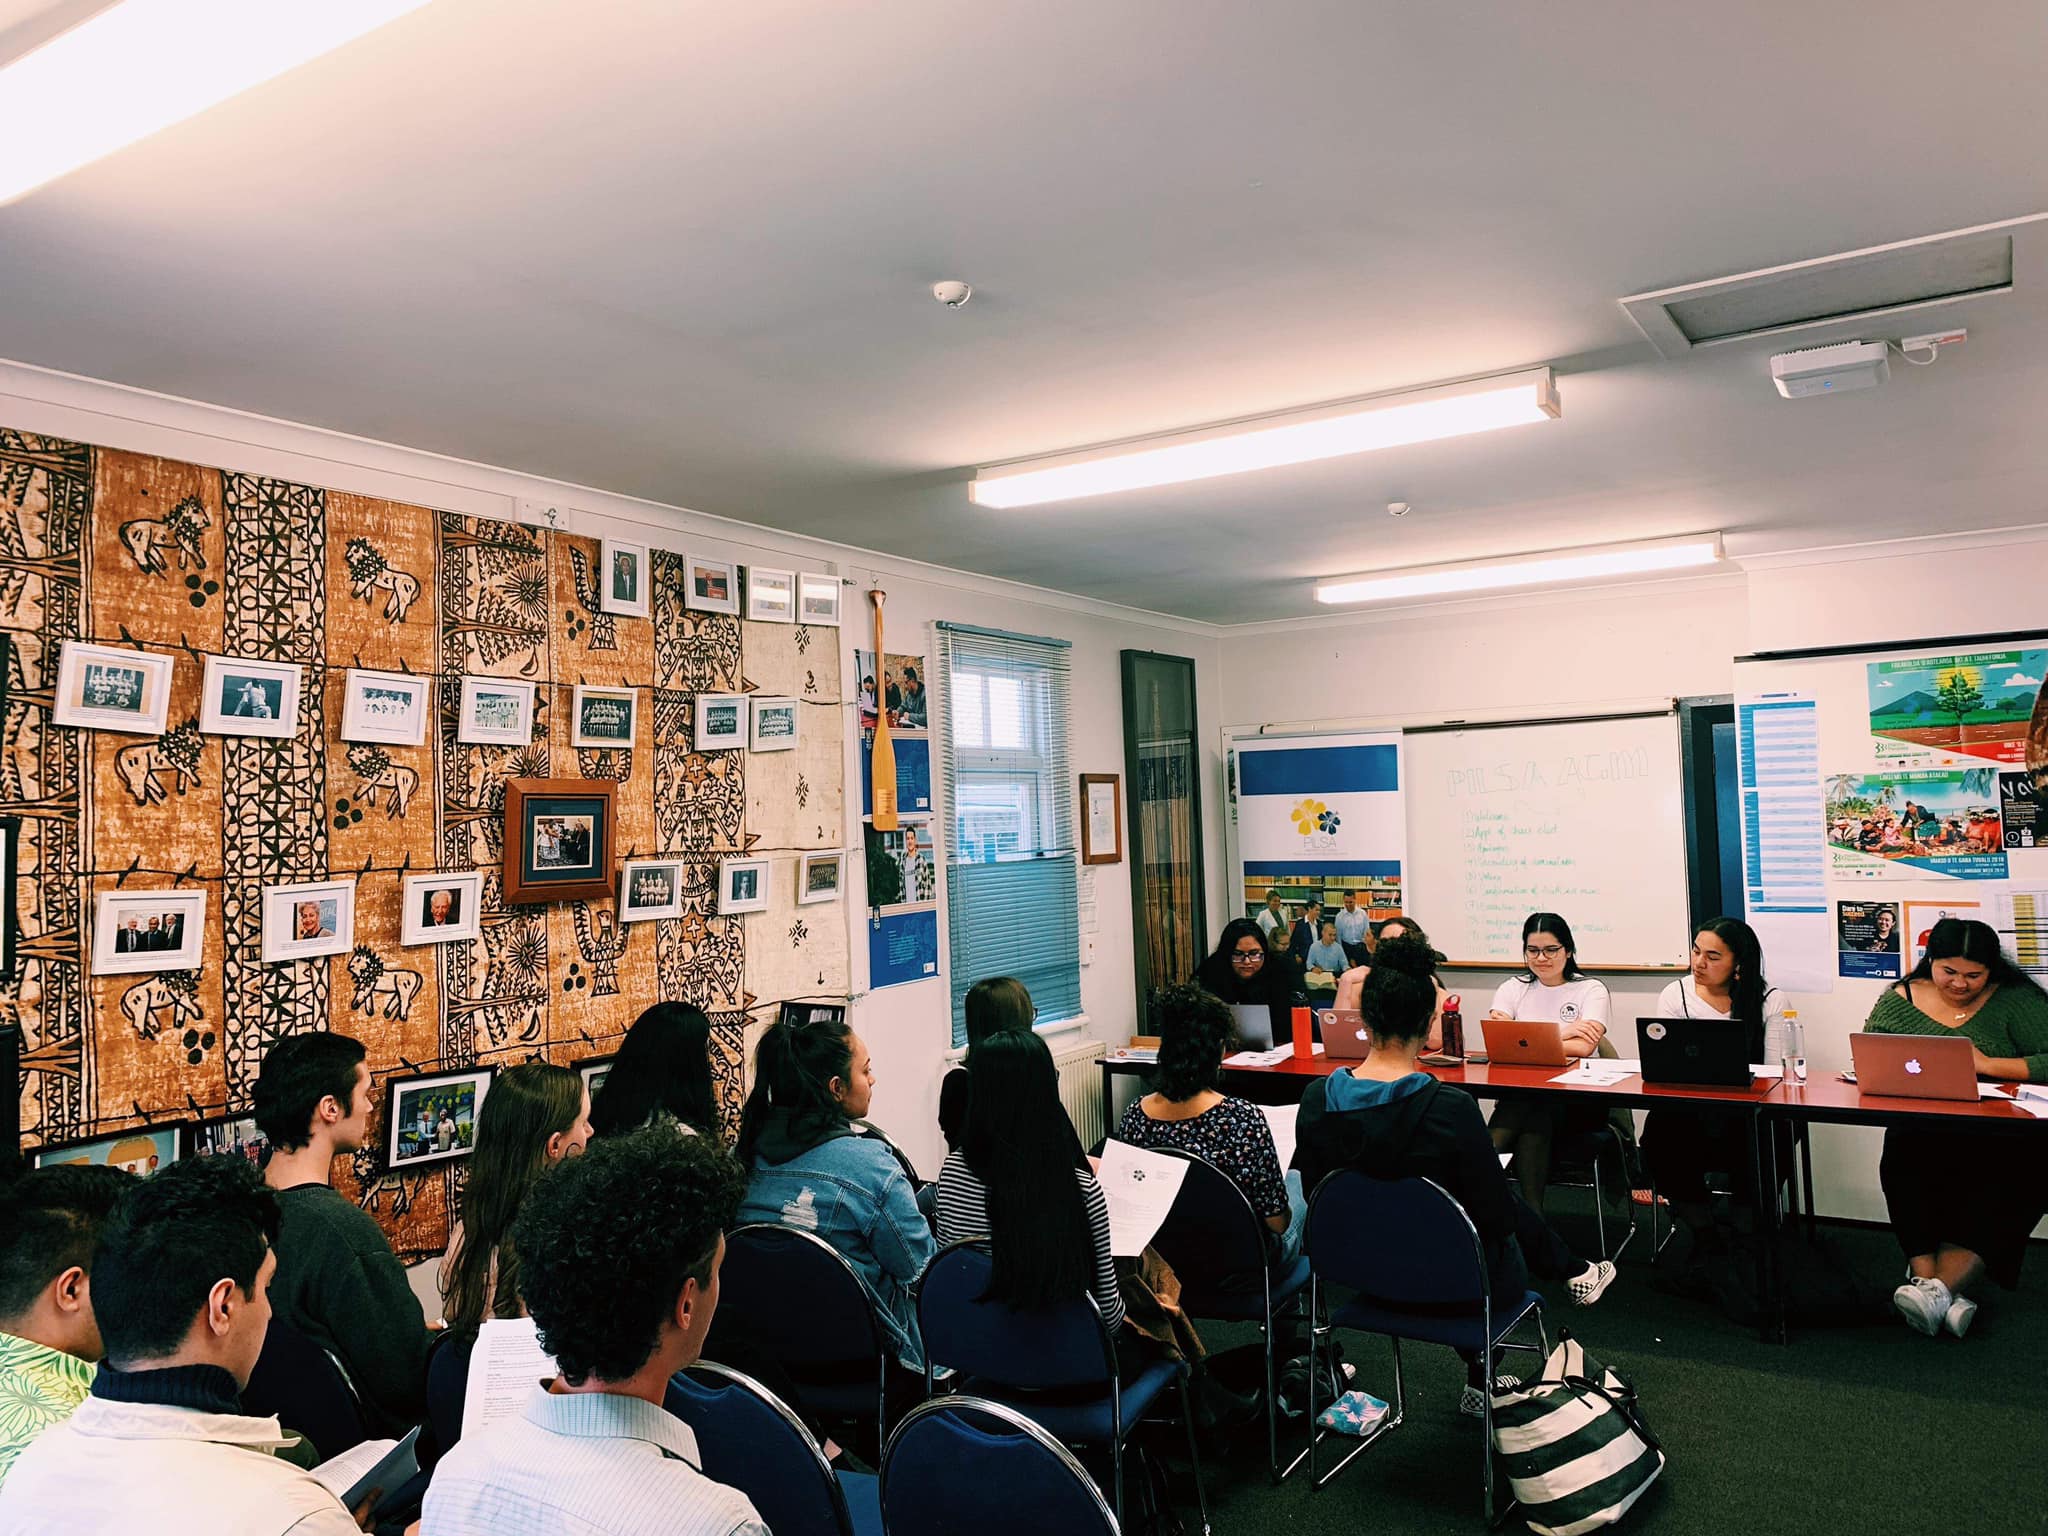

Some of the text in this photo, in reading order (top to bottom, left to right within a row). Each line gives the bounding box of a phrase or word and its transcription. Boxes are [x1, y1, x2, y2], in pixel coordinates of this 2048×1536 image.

[1447, 759, 1547, 797] PILSA
[1304, 836, 1337, 848] PILSA
[1857, 904, 1864, 912] to
